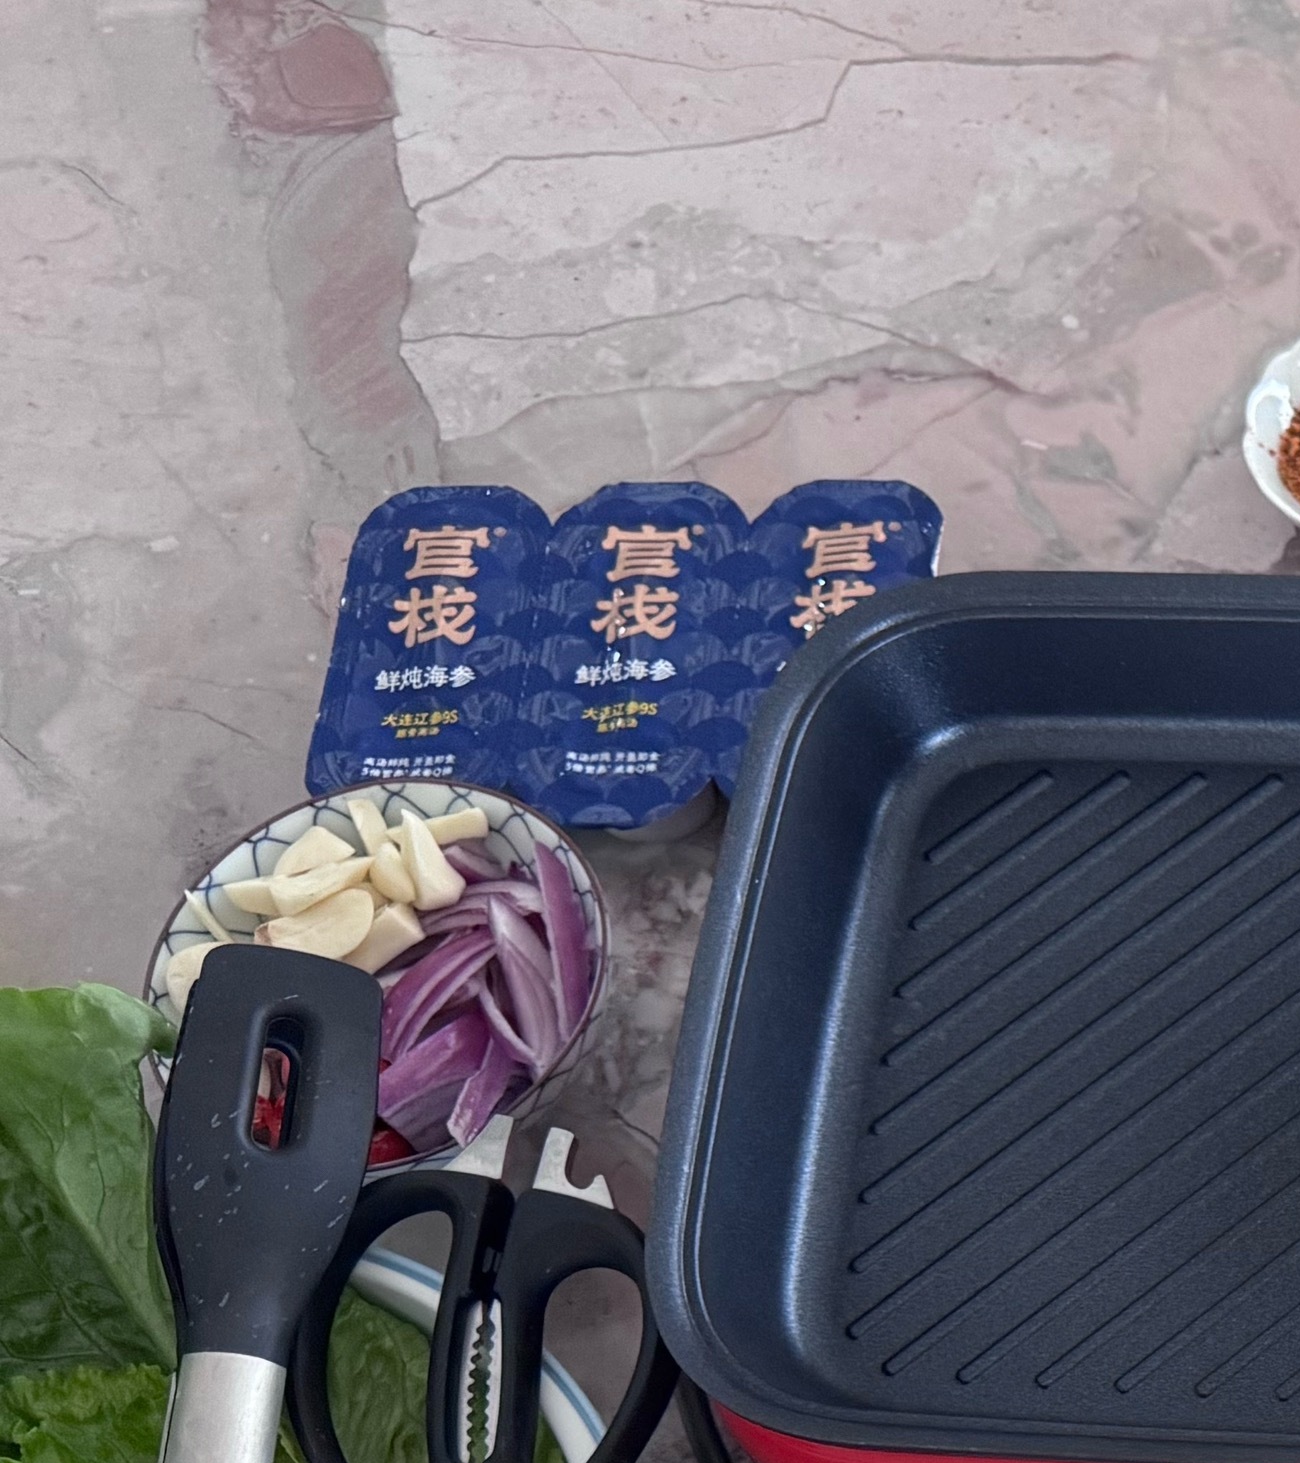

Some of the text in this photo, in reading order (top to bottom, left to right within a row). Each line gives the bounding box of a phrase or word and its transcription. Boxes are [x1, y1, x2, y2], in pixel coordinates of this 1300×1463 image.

[388, 525, 491, 649] 官栈
[591, 524, 693, 644] 官栈
[374, 665, 476, 692] 鲜炖海参
[574, 658, 677, 687] 鲜炖海参
